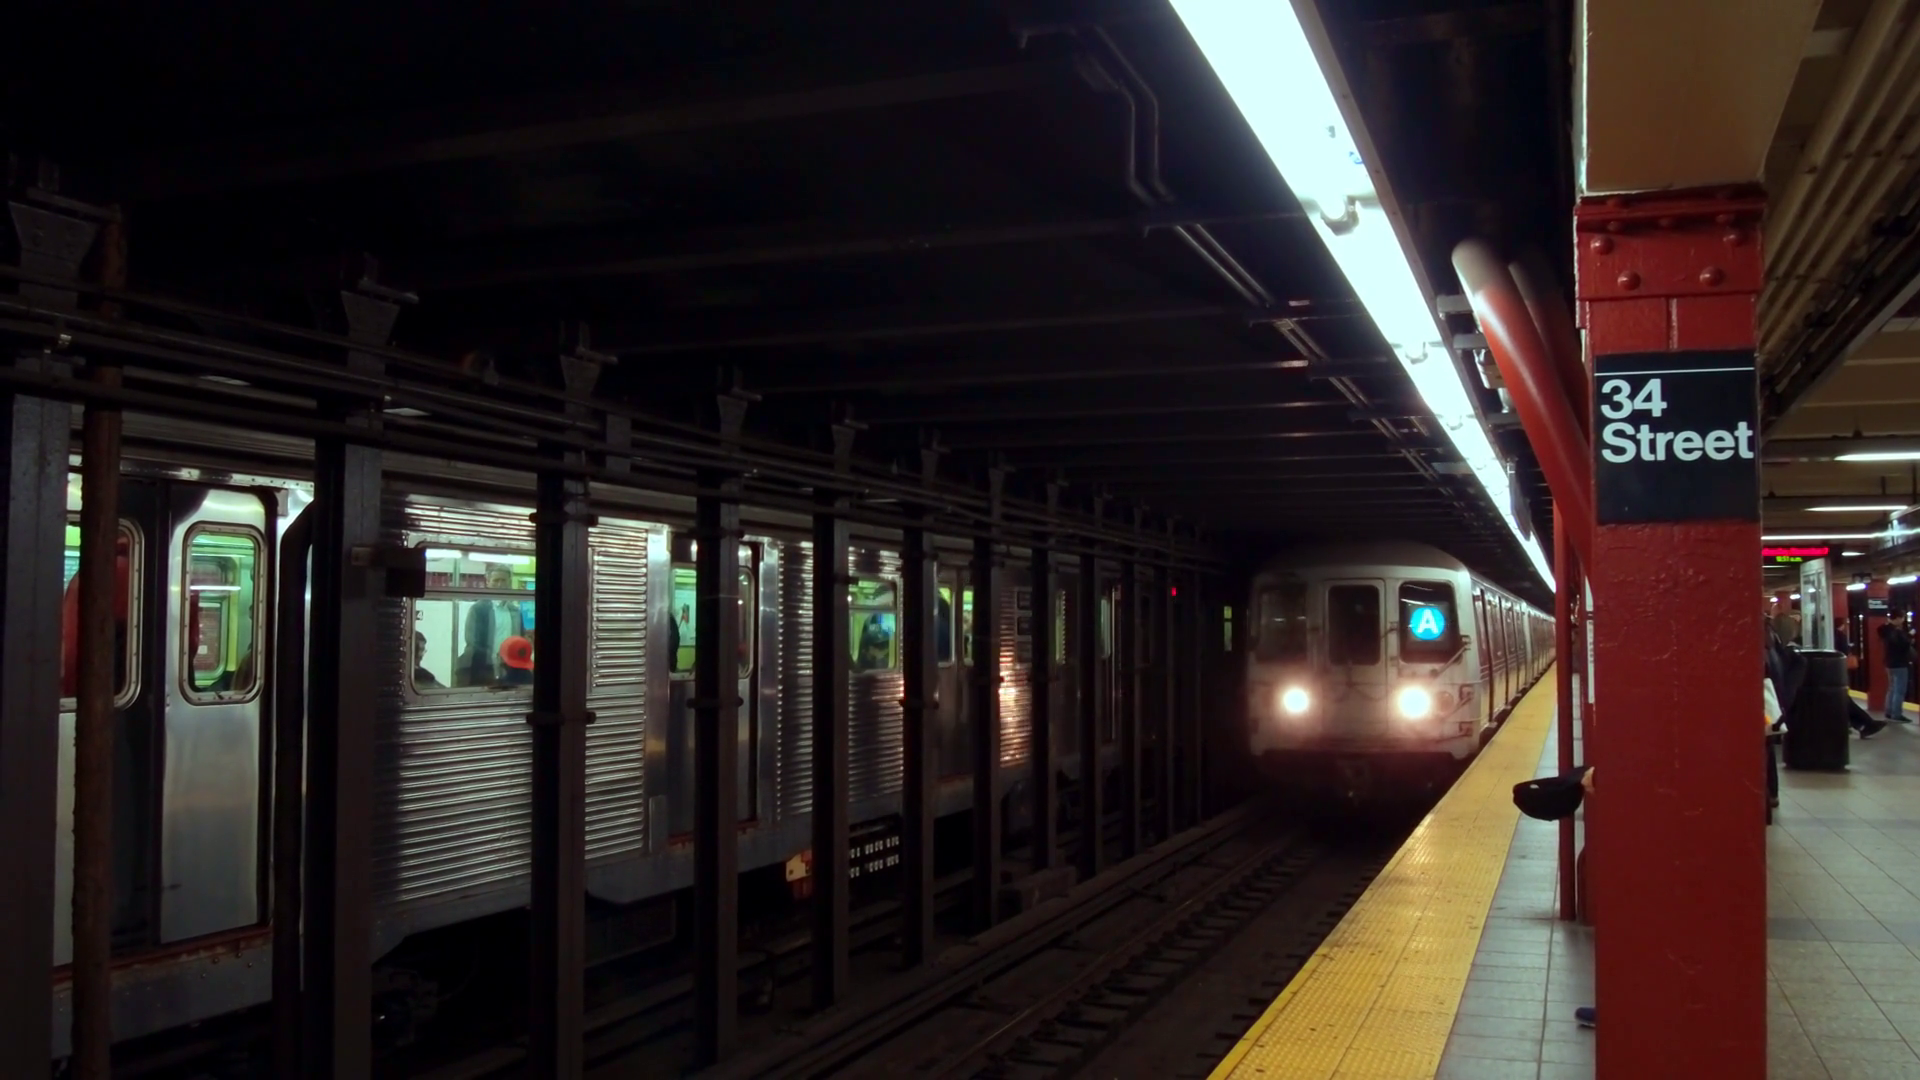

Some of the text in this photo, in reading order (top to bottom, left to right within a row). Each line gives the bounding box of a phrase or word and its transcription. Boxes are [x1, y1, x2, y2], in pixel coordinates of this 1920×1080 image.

[1600, 378, 1668, 420] 34
[1601, 421, 1755, 464] Street
[1417, 609, 1439, 634] A
